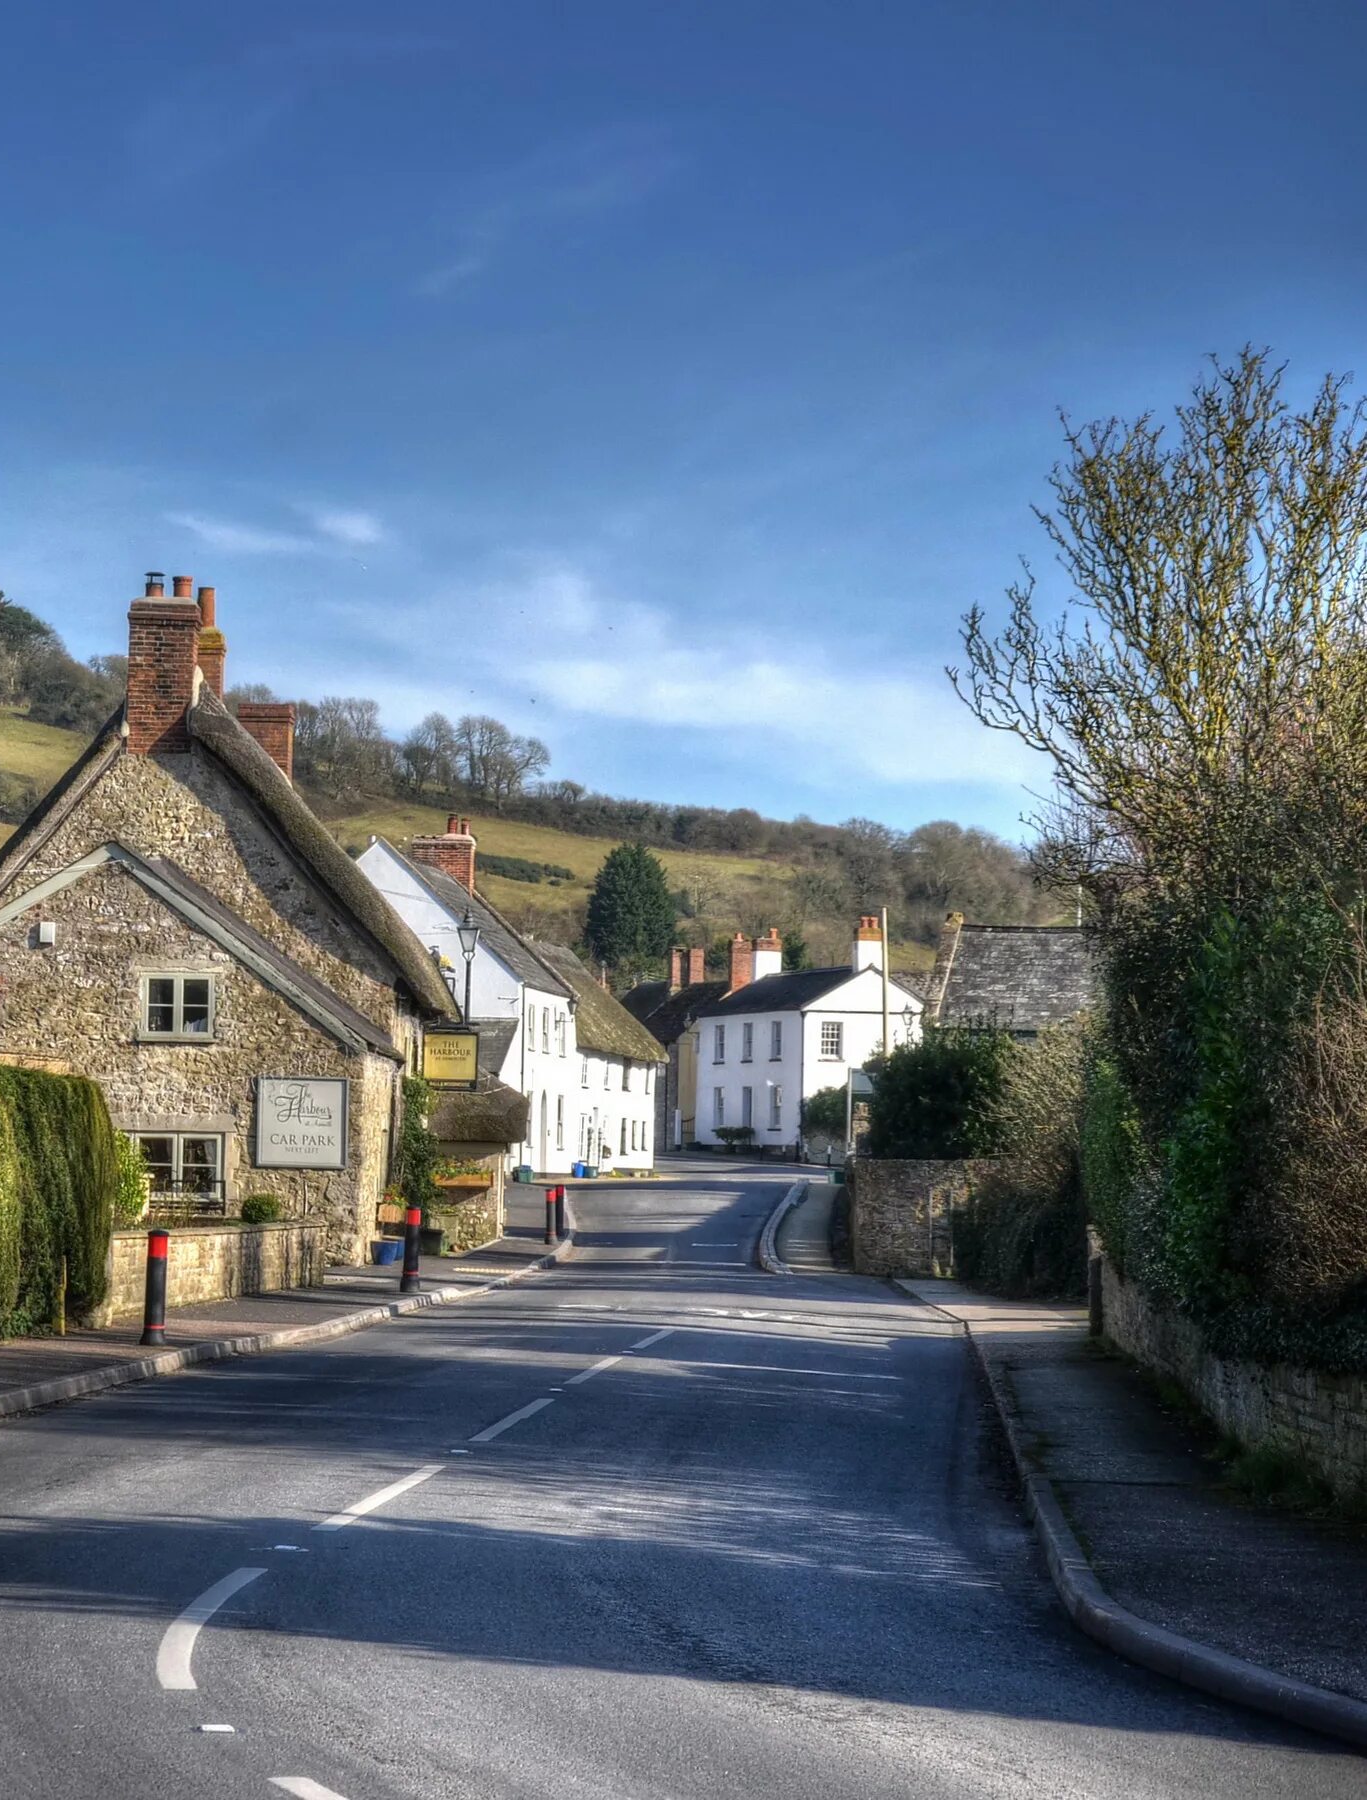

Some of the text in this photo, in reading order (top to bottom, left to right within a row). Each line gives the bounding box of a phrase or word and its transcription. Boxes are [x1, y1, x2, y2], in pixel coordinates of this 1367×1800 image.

[443, 1040, 459, 1048] THE
[430, 1048, 472, 1056] HARBOUR
[270, 1134, 336, 1147] CAR PARK
